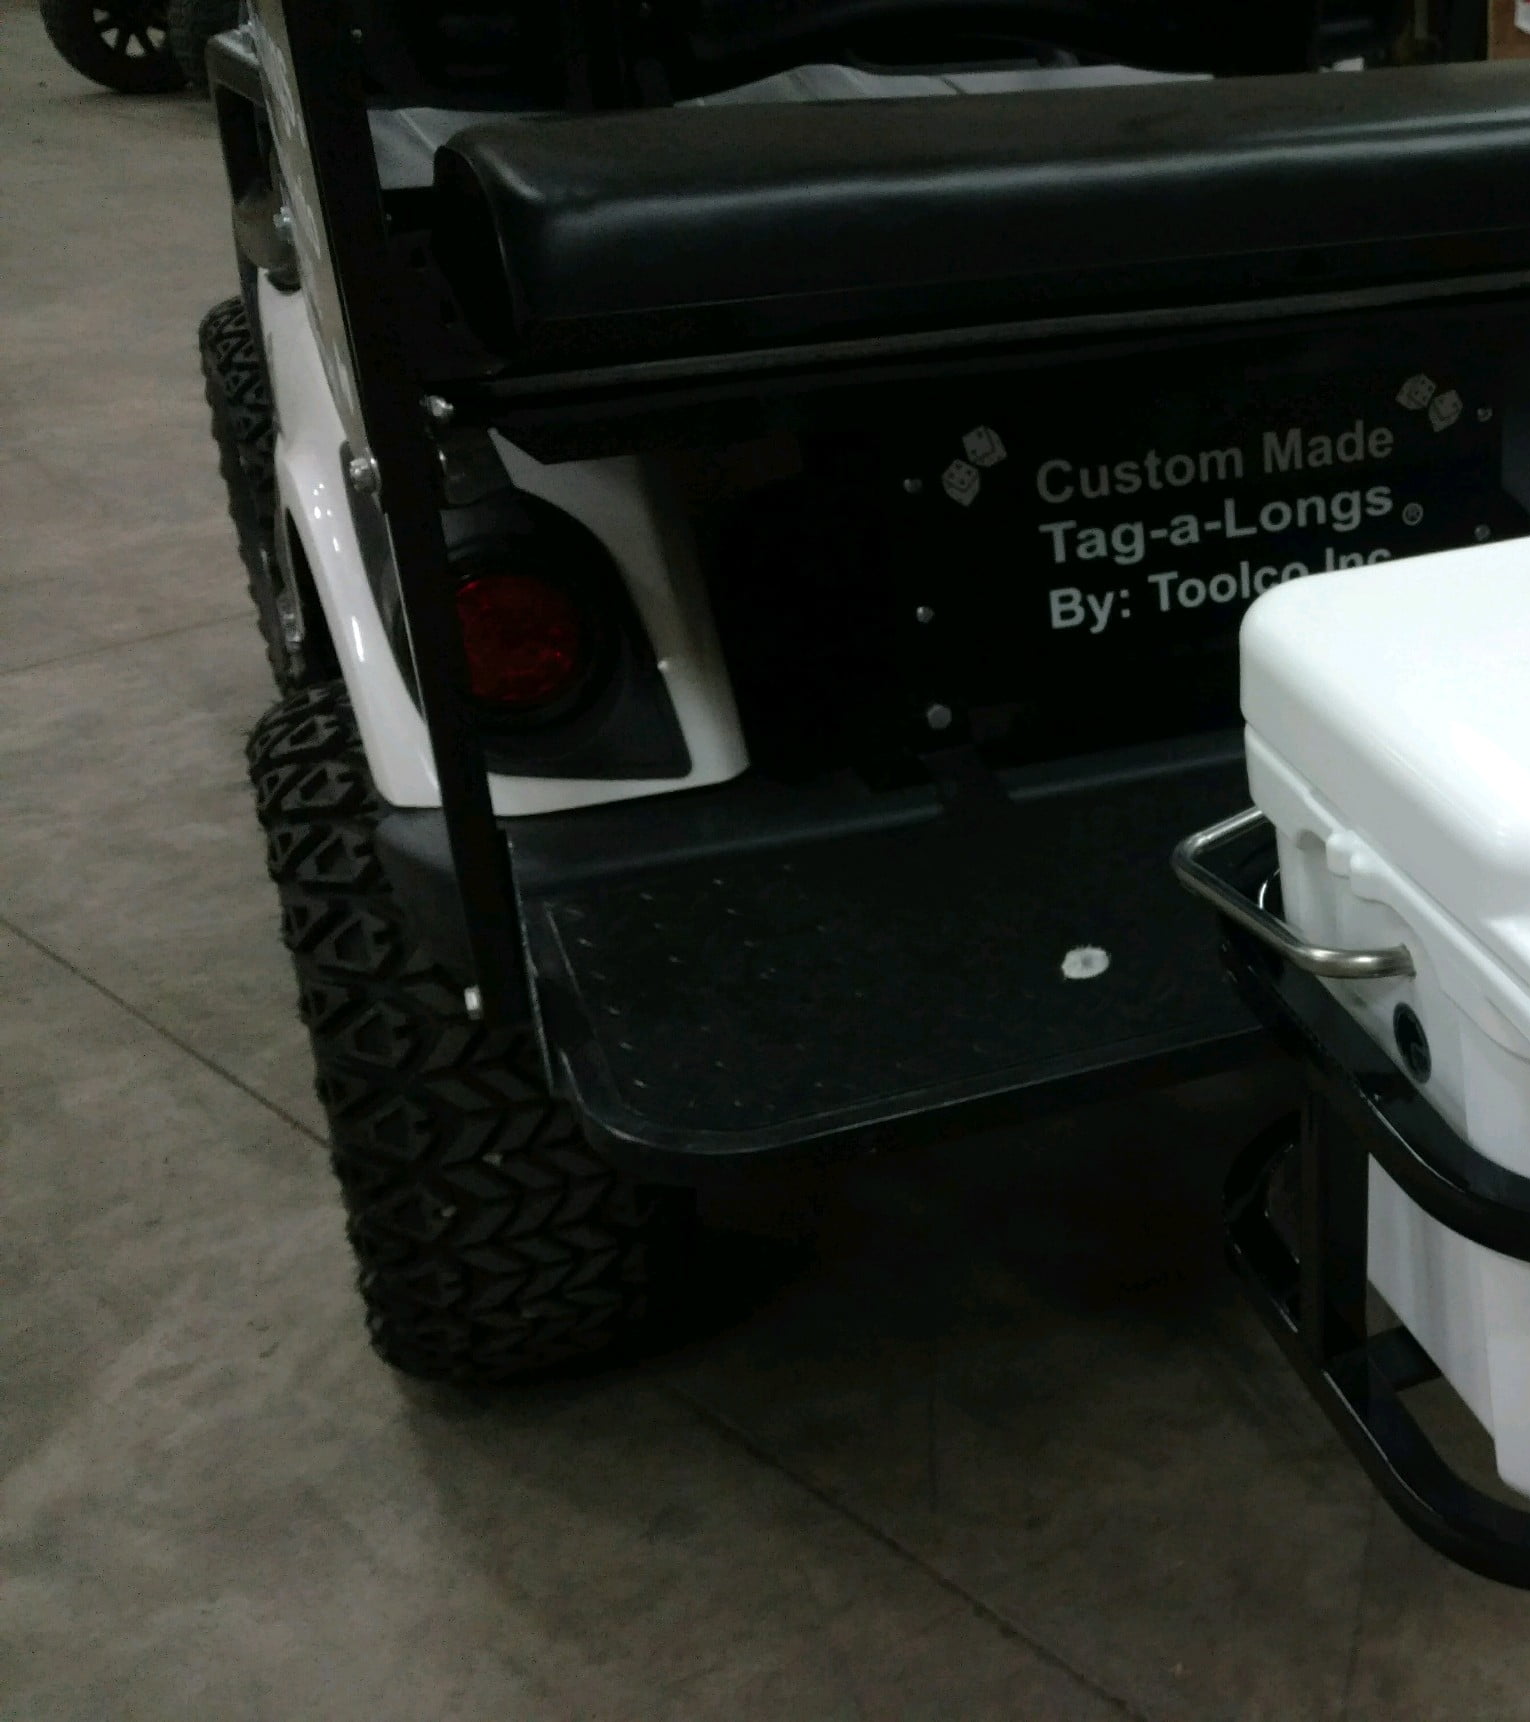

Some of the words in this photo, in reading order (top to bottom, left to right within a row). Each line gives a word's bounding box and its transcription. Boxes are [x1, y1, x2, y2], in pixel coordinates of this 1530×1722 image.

[1037, 447, 1243, 503] Custom
[1263, 419, 1394, 473] Made
[1049, 586, 1131, 635] By:
